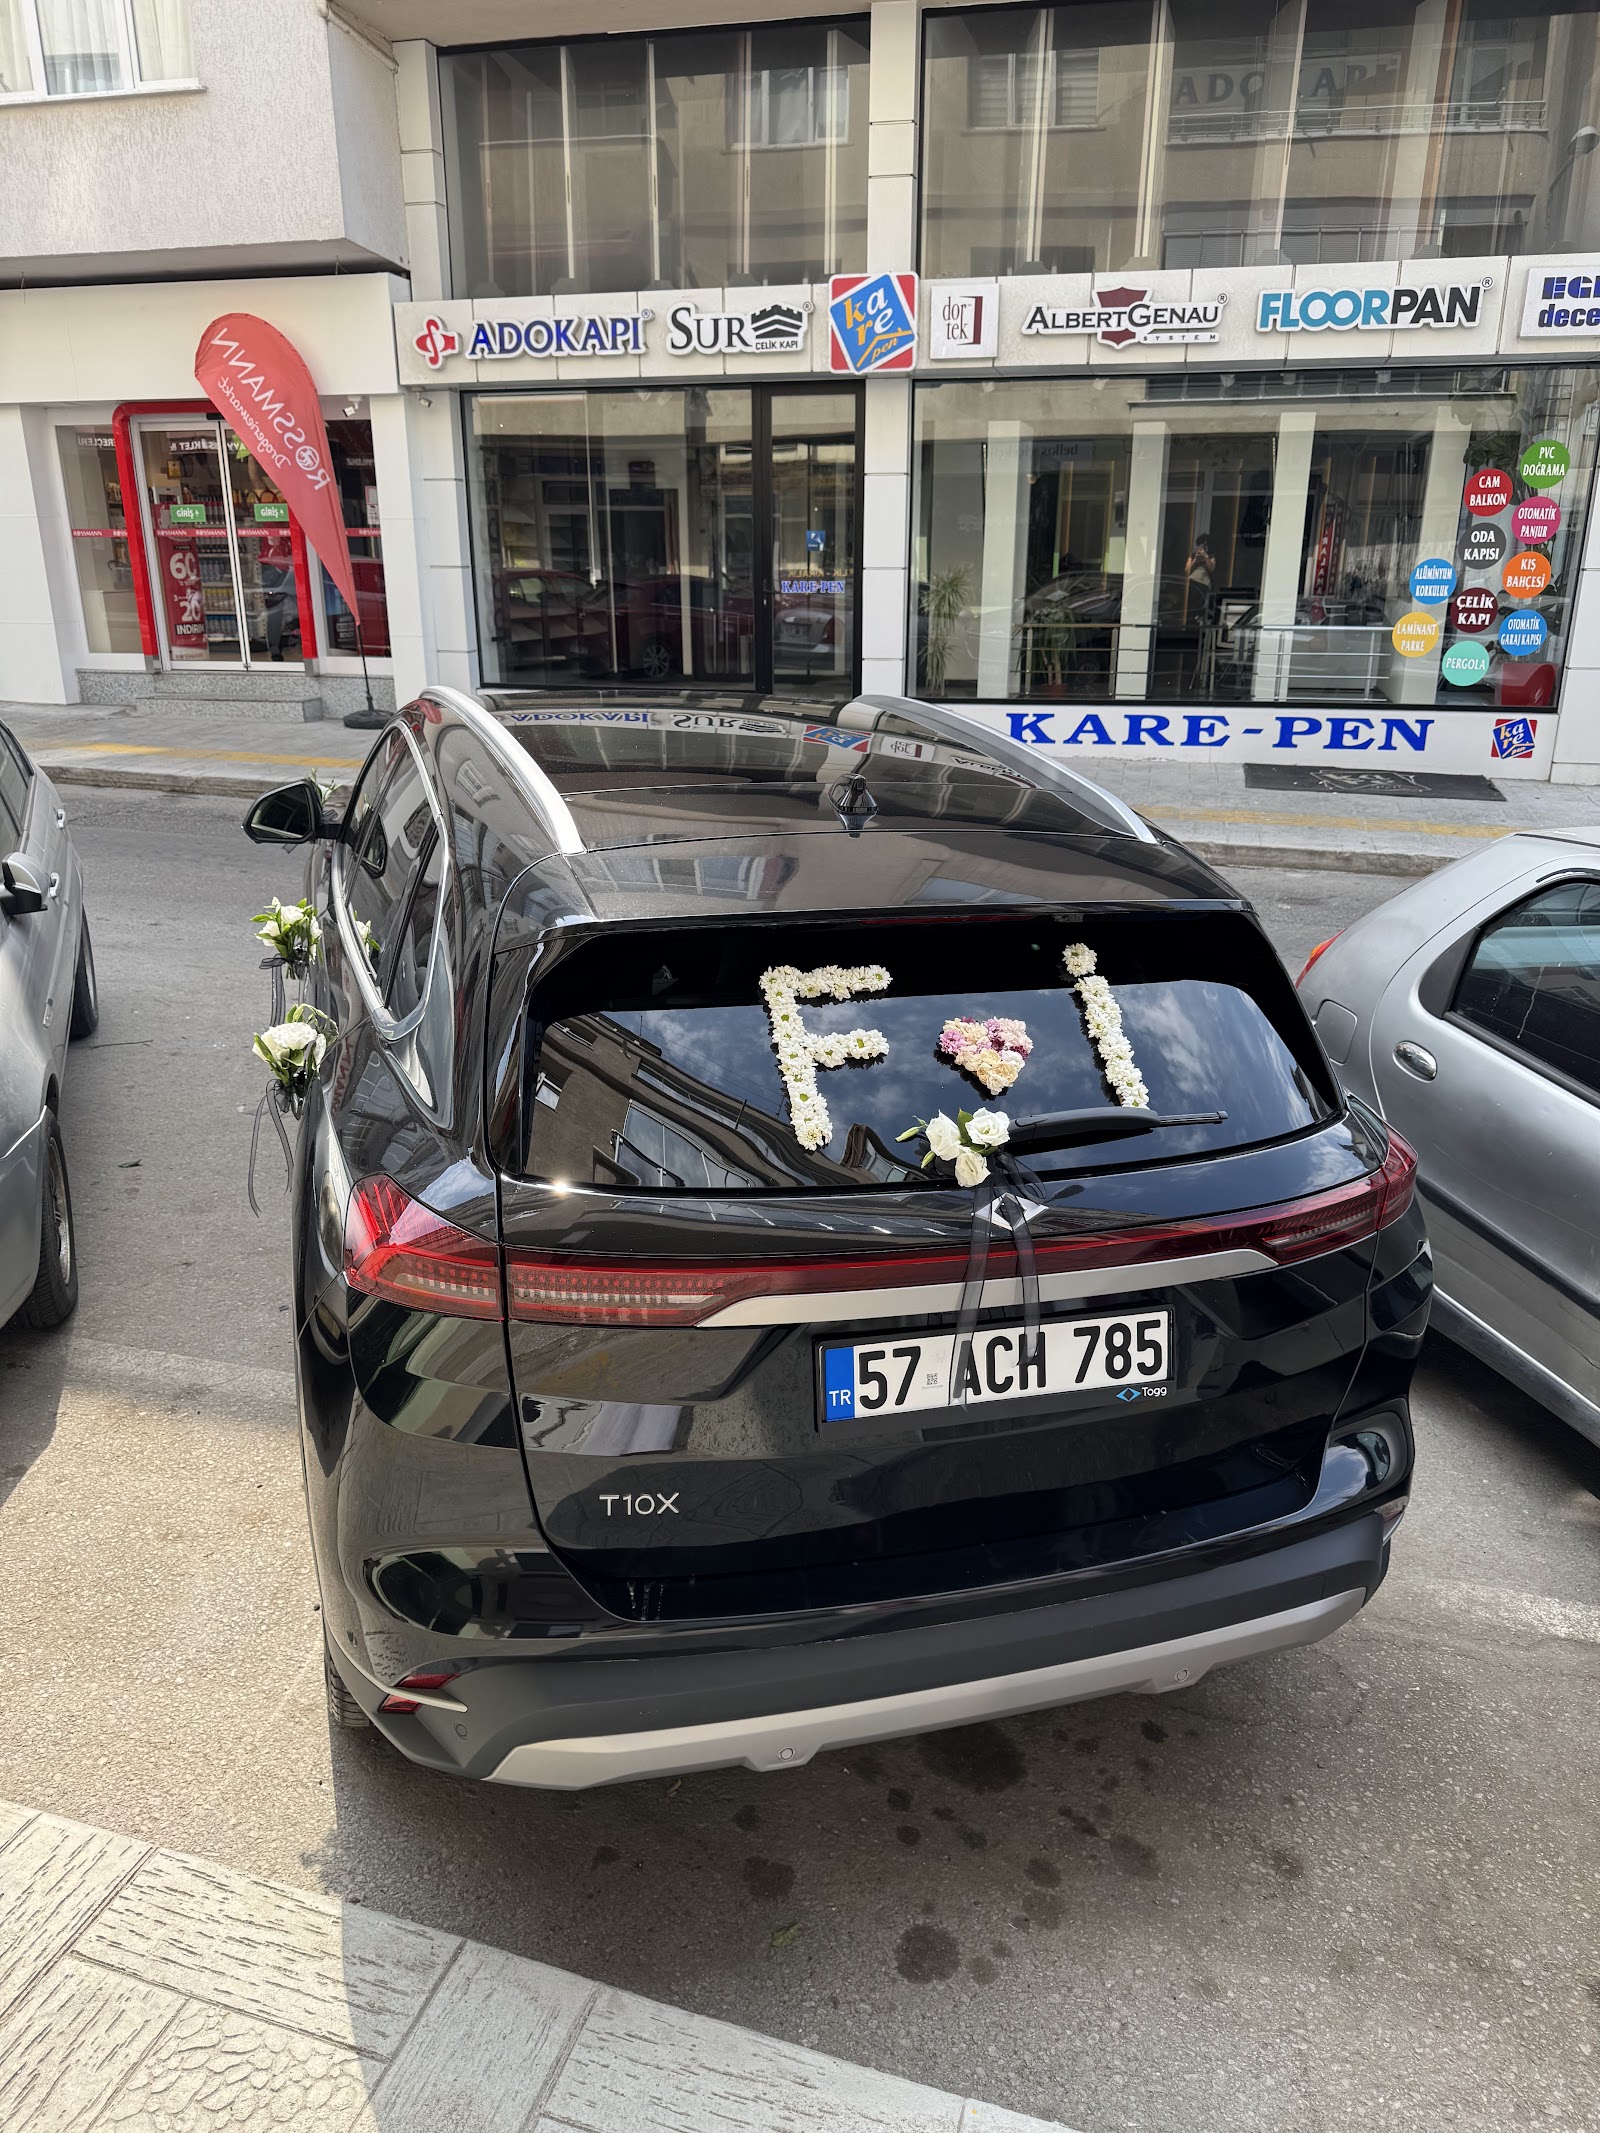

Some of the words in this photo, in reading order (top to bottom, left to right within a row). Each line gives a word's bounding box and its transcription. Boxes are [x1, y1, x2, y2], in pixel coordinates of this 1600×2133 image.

[942, 295, 967, 322] dor
[1259, 286, 1480, 328] FLOORPAN
[670, 306, 753, 350] SUR
[945, 317, 969, 341] tek
[469, 316, 641, 356] ADOKAPI
[1142, 333, 1217, 342] SYSTEM
[779, 341, 798, 349] KAPI
[871, 337, 898, 364] pen
[1538, 446, 1556, 459] PVC
[1522, 461, 1566, 476] DOĞRAMA
[1478, 475, 1501, 489] CAM
[1469, 493, 1507, 506] BALKON
[176, 507, 194, 519] GİRİŞ
[260, 506, 279, 518] GİRİŞ
[1517, 504, 1557, 520] OTOMATİK
[1470, 530, 1496, 543] ODA
[1520, 525, 1548, 539] PANJUR
[1463, 547, 1500, 560] KAPISI
[1520, 558, 1537, 572] KIŞ
[1414, 565, 1453, 580] ALÜMİNYUM
[781, 580, 846, 594] KARE-PEN
[1506, 573, 1546, 590] BAHÇESİ
[1415, 584, 1450, 597] KORKULUK
[1456, 593, 1495, 611] ÇELİK
[1457, 612, 1491, 625] KAPI
[1507, 615, 1541, 630] OTOMATİK
[1396, 620, 1437, 636] LAMİNANT
[1400, 640, 1425, 652] PARKE
[1500, 633, 1521, 646] GARAJ
[1520, 633, 1542, 646] KAPISI
[1445, 657, 1486, 671] PERGOLA
[858, 1345, 922, 1410] 57
[952, 1331, 1047, 1399] ACH
[1073, 1319, 1163, 1384] 785
[828, 1389, 852, 1407] TR
[1141, 1386, 1168, 1397] Togg
[598, 1491, 680, 1517] T10X
